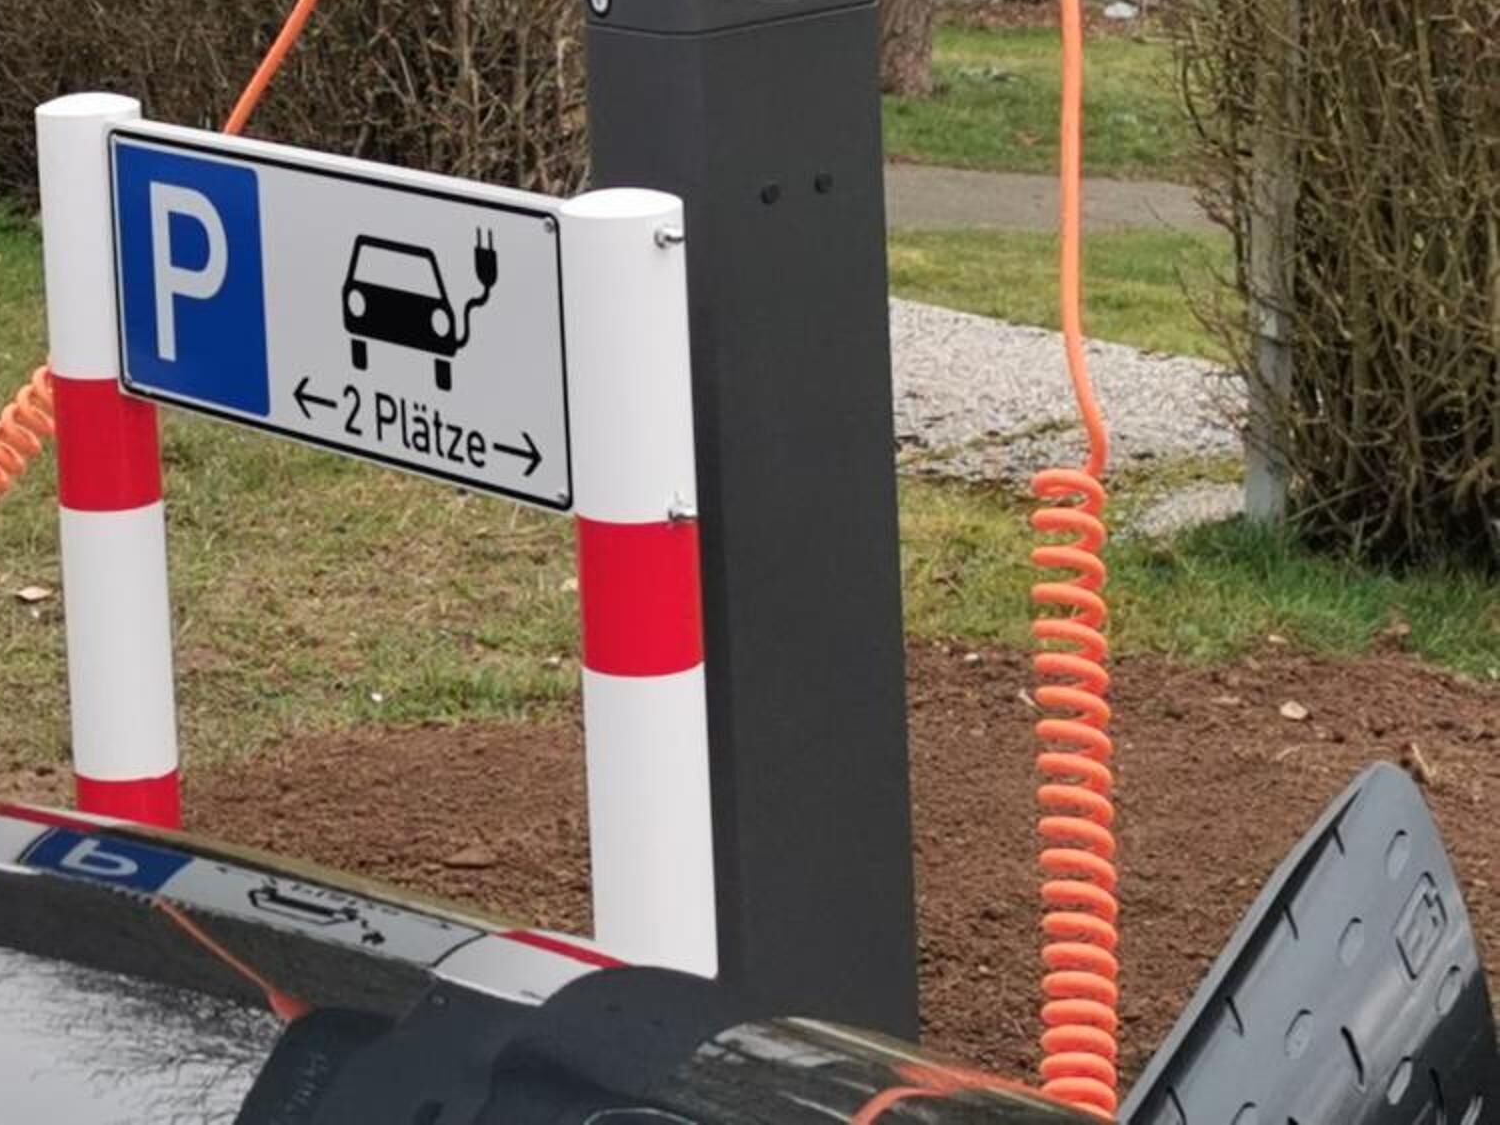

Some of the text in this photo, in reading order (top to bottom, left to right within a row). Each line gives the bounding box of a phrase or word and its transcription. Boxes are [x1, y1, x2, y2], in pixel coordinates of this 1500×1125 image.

[149, 181, 228, 362] P
[343, 384, 486, 468] 2 Plätze
